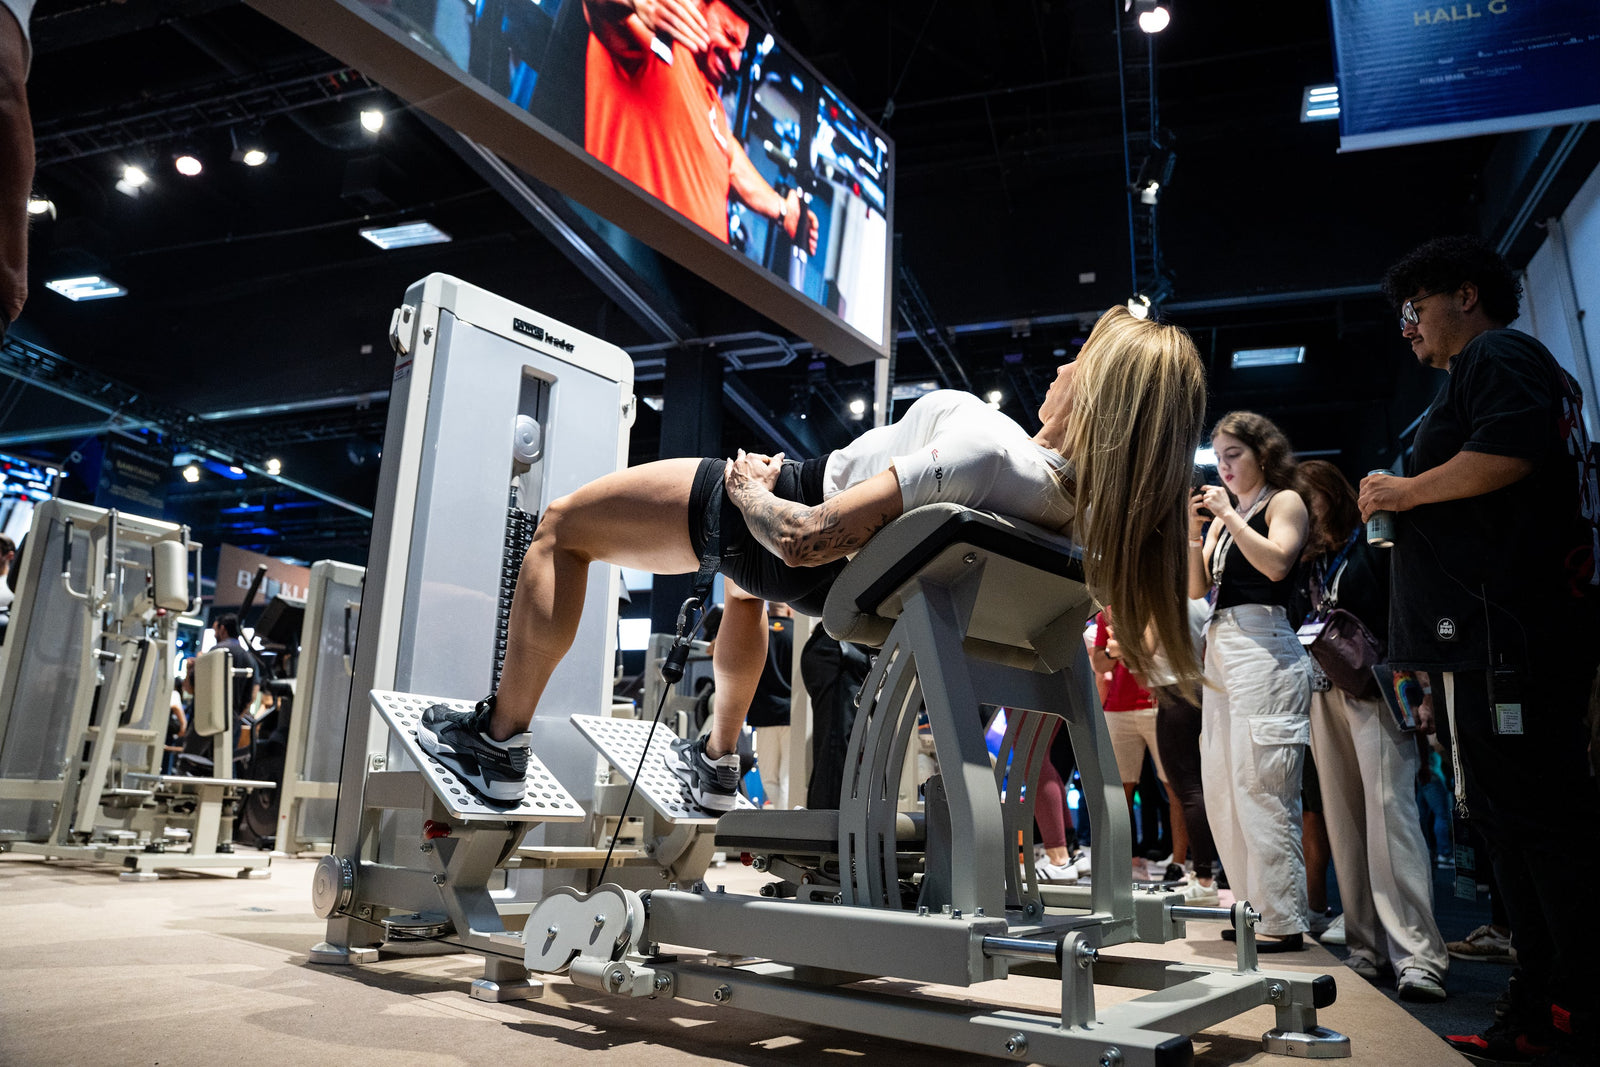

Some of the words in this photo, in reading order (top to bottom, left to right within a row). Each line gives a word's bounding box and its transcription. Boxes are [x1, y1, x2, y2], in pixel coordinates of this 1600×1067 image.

[1413, 3, 1481, 26] HALL
[1488, 0, 1508, 14] G
[935, 466, 943, 480] 30
